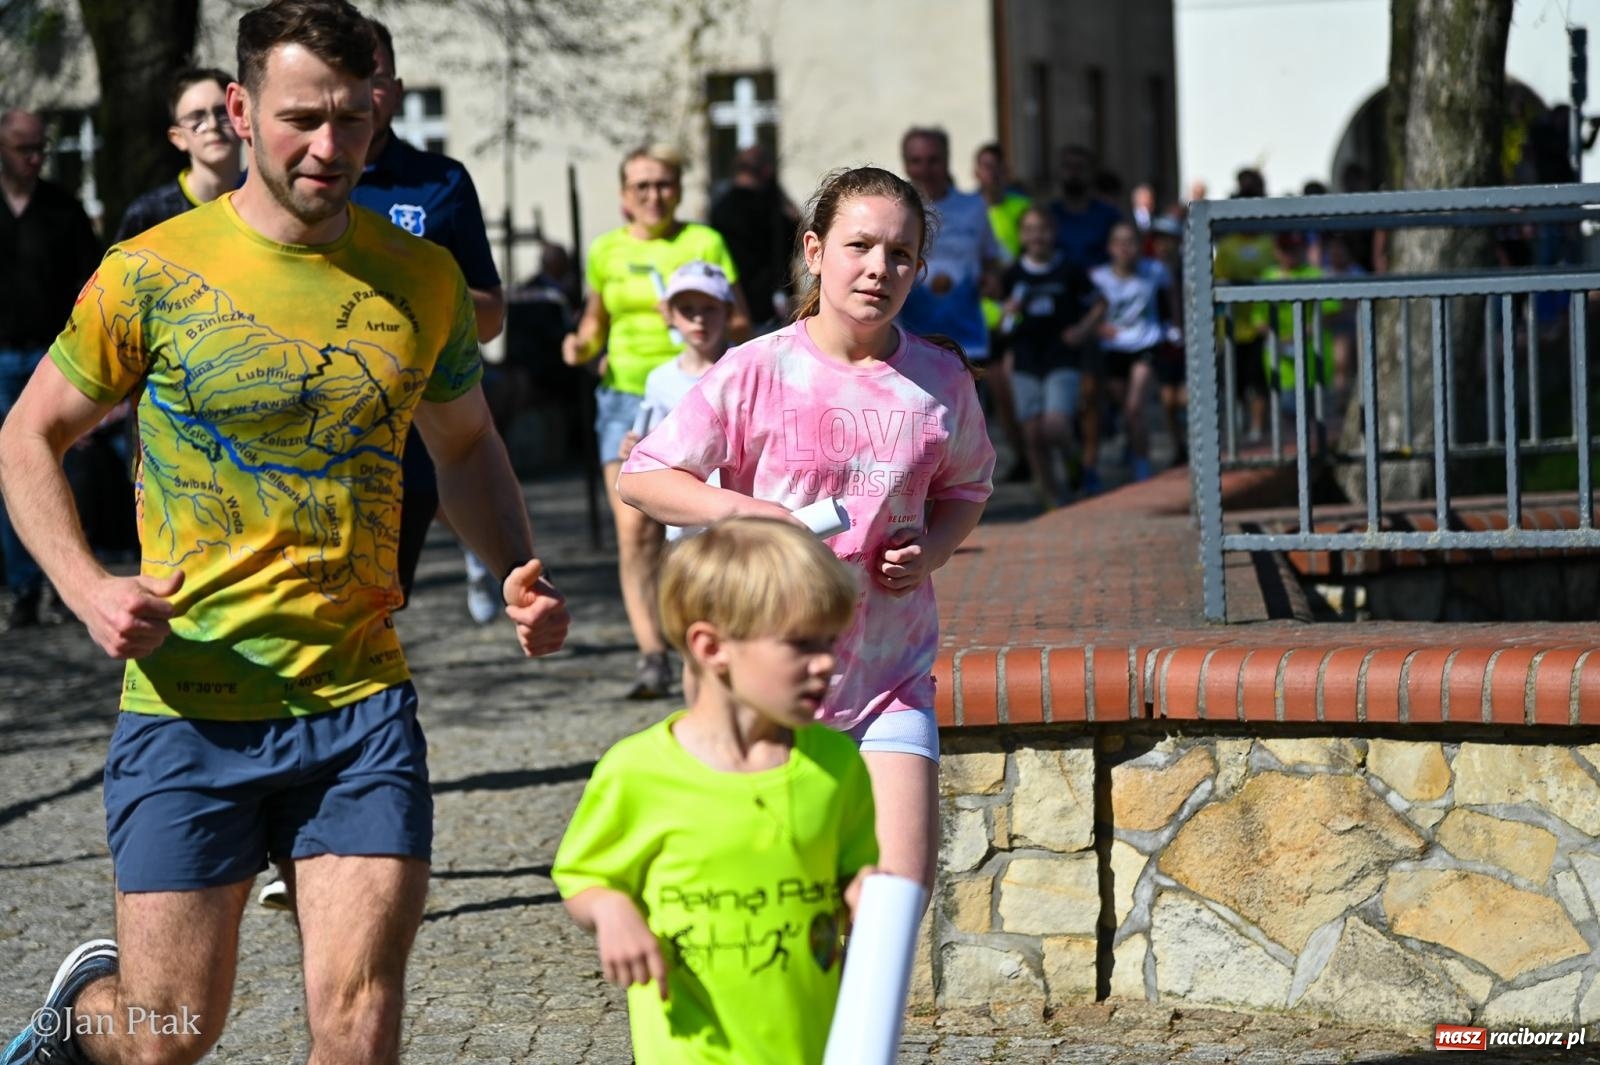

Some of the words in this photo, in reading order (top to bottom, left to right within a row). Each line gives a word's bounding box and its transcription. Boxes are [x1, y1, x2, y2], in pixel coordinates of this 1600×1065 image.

[364, 320, 400, 332] Artur
[782, 407, 939, 465] LOVE
[785, 466, 929, 498] YOURSELF
[226, 496, 245, 535] Woda
